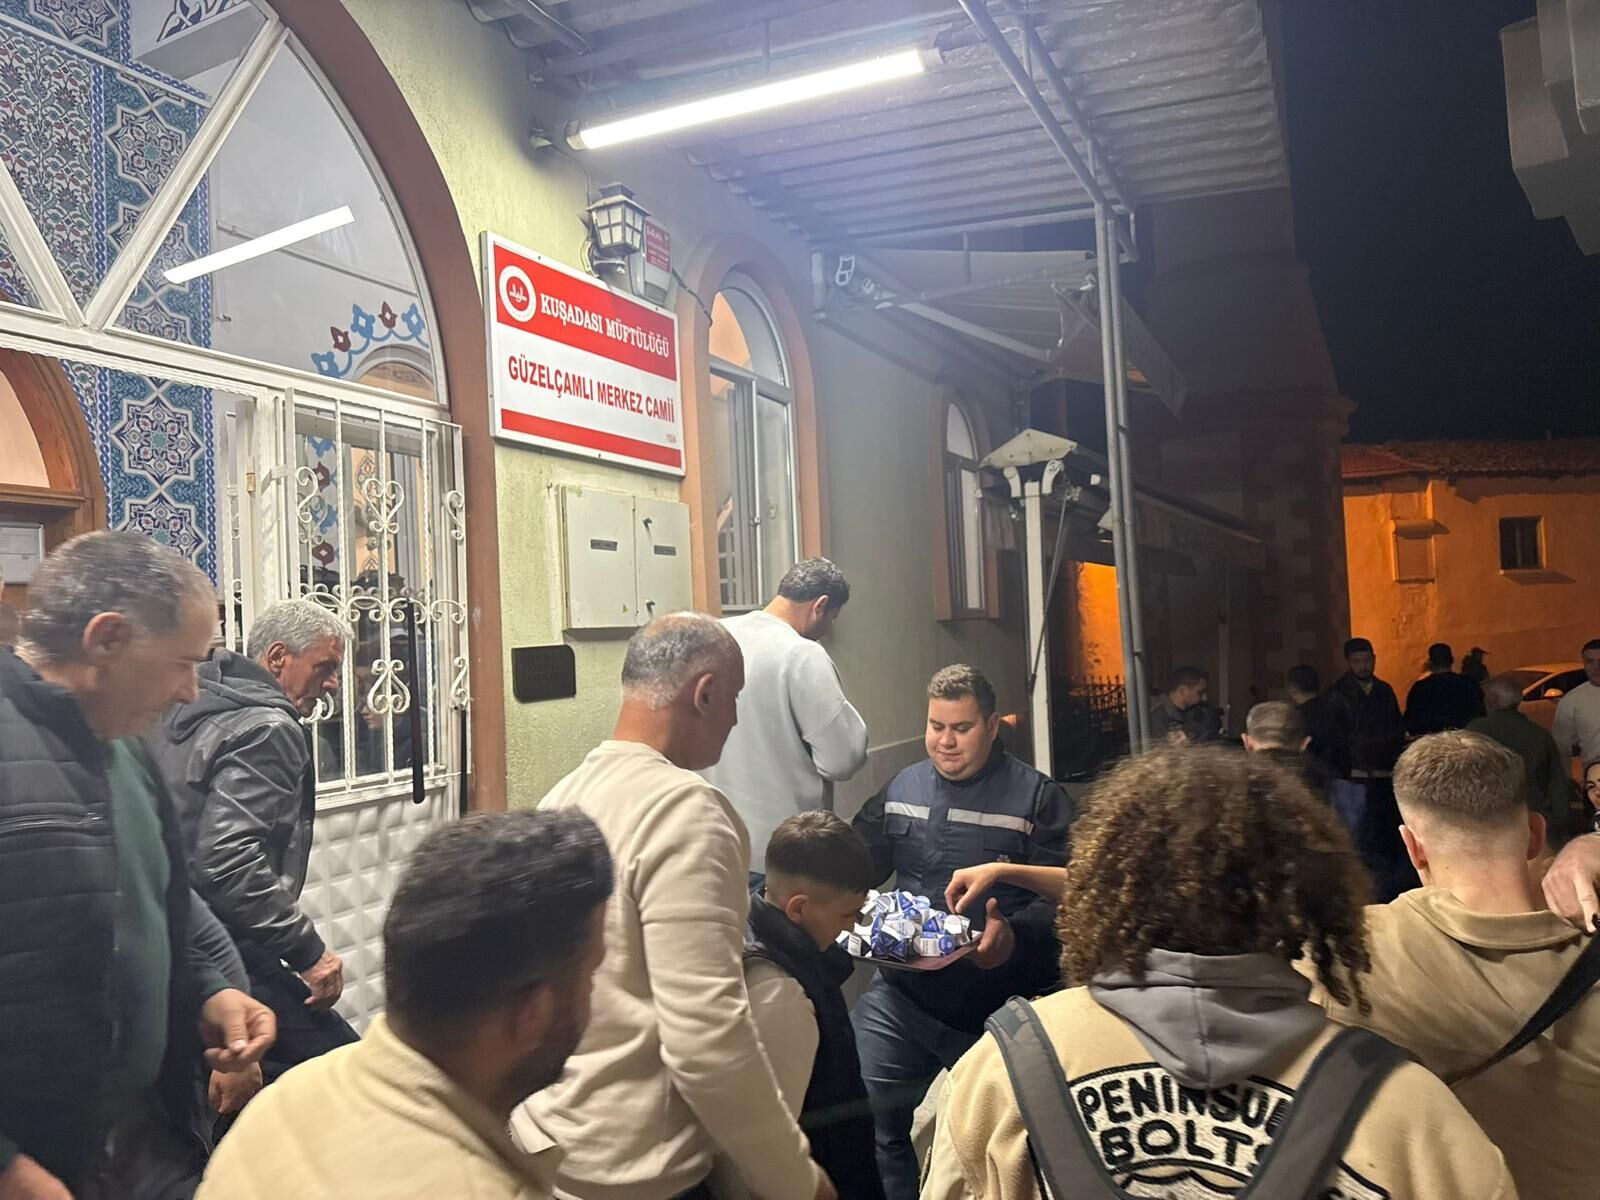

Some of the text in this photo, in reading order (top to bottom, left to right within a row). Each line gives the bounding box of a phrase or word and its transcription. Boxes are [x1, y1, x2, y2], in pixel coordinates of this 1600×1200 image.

[540, 292, 603, 334] KUŞADASI
[605, 318, 669, 358] MÜFTÜLÜĞÜ
[508, 354, 675, 423] GÜZELÇAMLI MERKEZ CAMİİ
